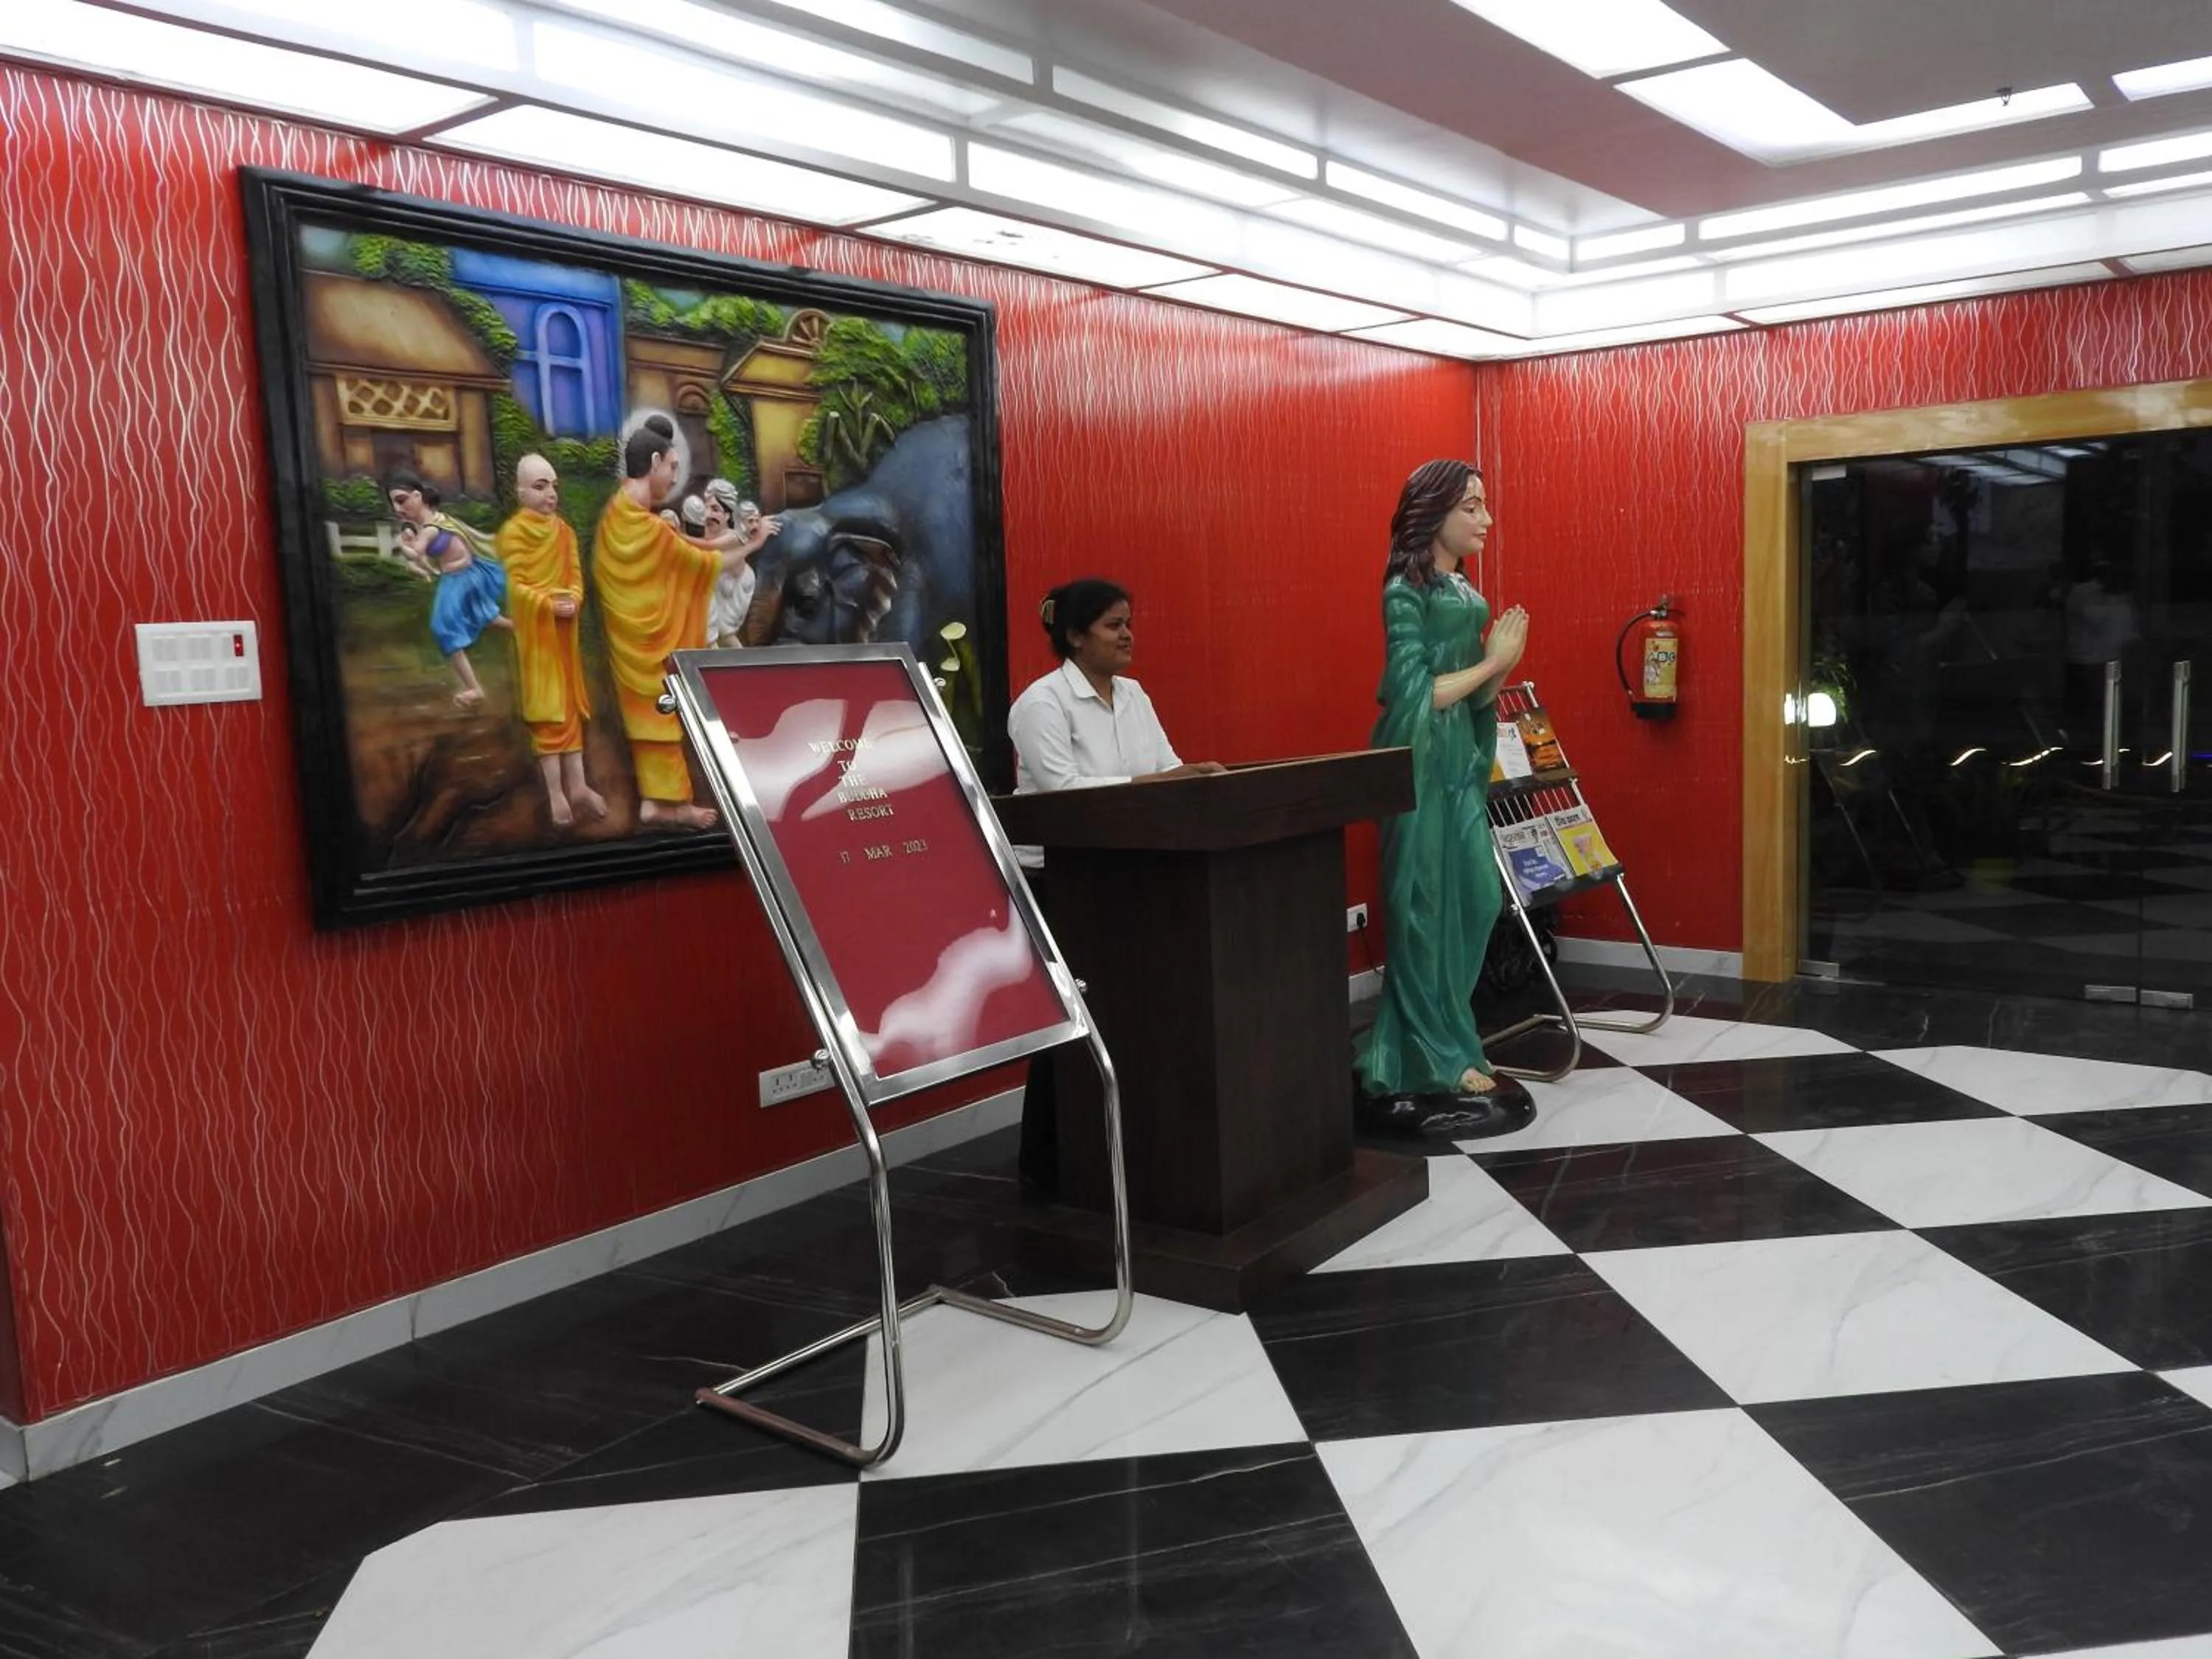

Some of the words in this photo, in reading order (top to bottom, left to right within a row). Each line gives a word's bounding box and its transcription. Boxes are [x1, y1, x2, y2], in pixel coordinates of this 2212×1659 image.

[808, 738, 872, 753] WELCOME
[838, 759, 856, 772] TO
[838, 773, 867, 787] THE
[838, 788, 888, 803] BUDDHA
[847, 804, 894, 821] RESORT
[864, 844, 893, 860] MAR
